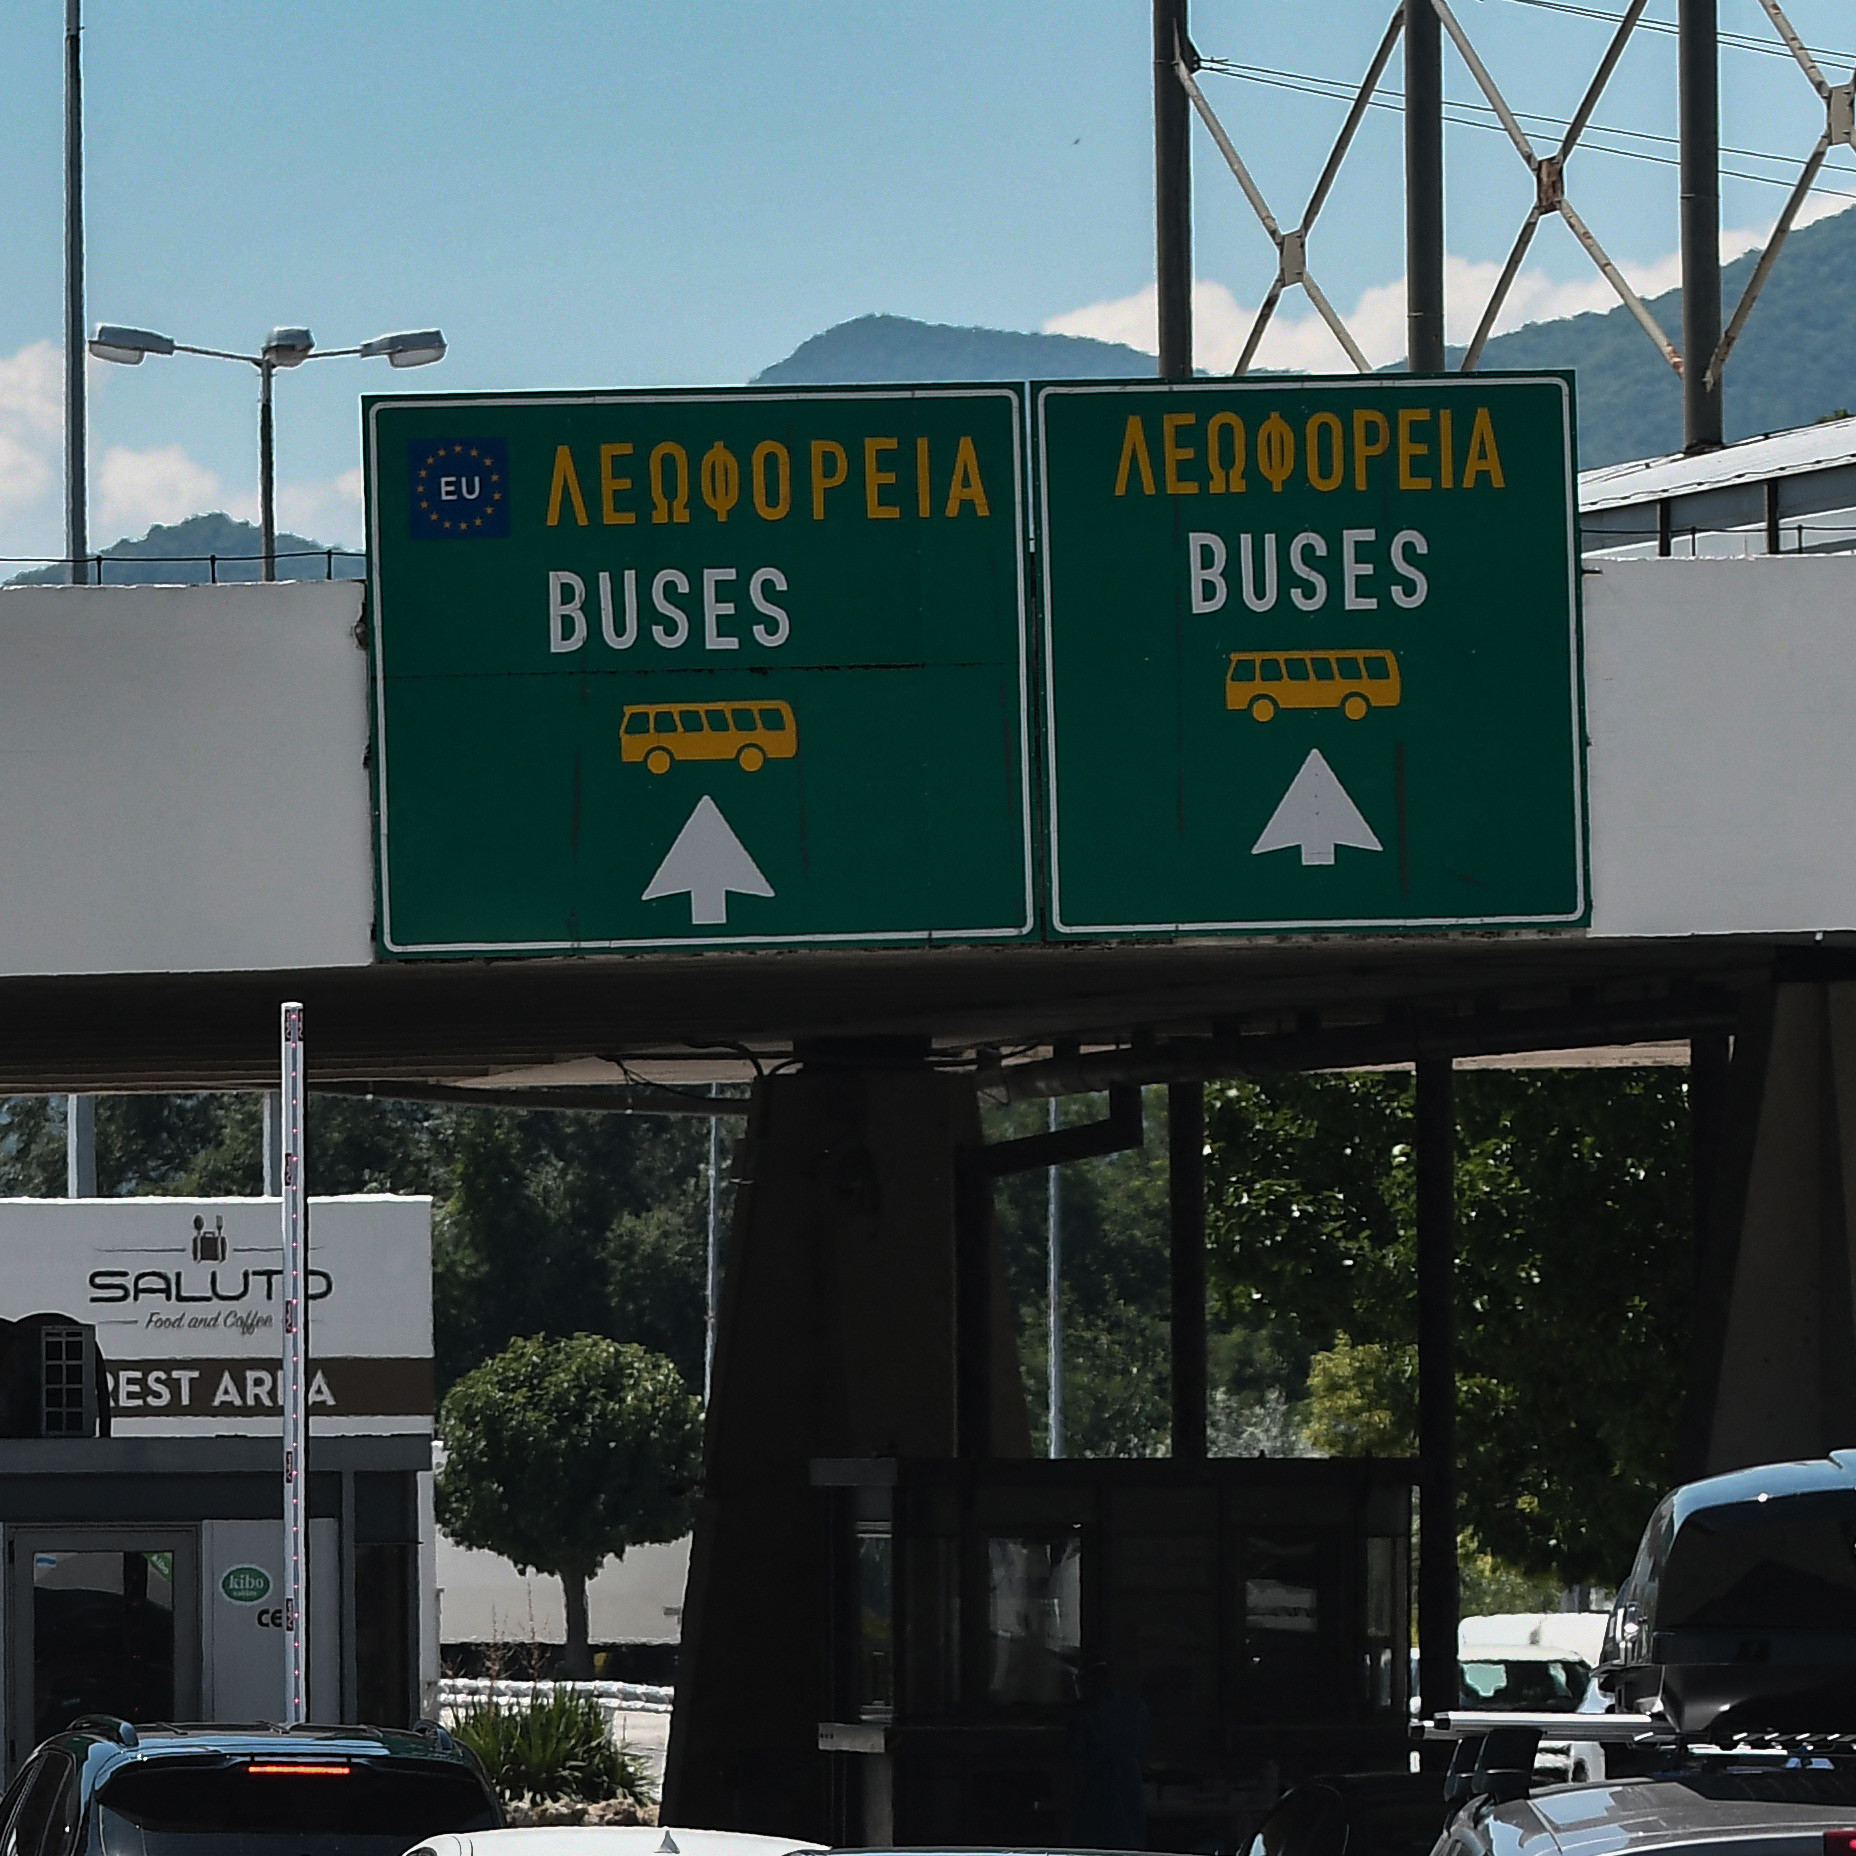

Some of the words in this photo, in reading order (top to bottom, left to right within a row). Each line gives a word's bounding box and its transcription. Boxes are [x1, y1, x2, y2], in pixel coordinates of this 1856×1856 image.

[546, 436, 990, 526] ΛΕΩΦΟΡΕΙΑ
[1114, 406, 1505, 496] ΛΕΩΦΟΡΕΙΑ
[440, 475, 480, 500] EU
[1188, 528, 1429, 615] BUSES
[548, 567, 790, 653] BUSES
[145, 1311, 185, 1329] Food
[188, 1311, 220, 1329] and
[223, 1310, 274, 1335] Coffee
[212, 1369, 337, 1407] ARA
[229, 1575, 264, 1589] kibo
